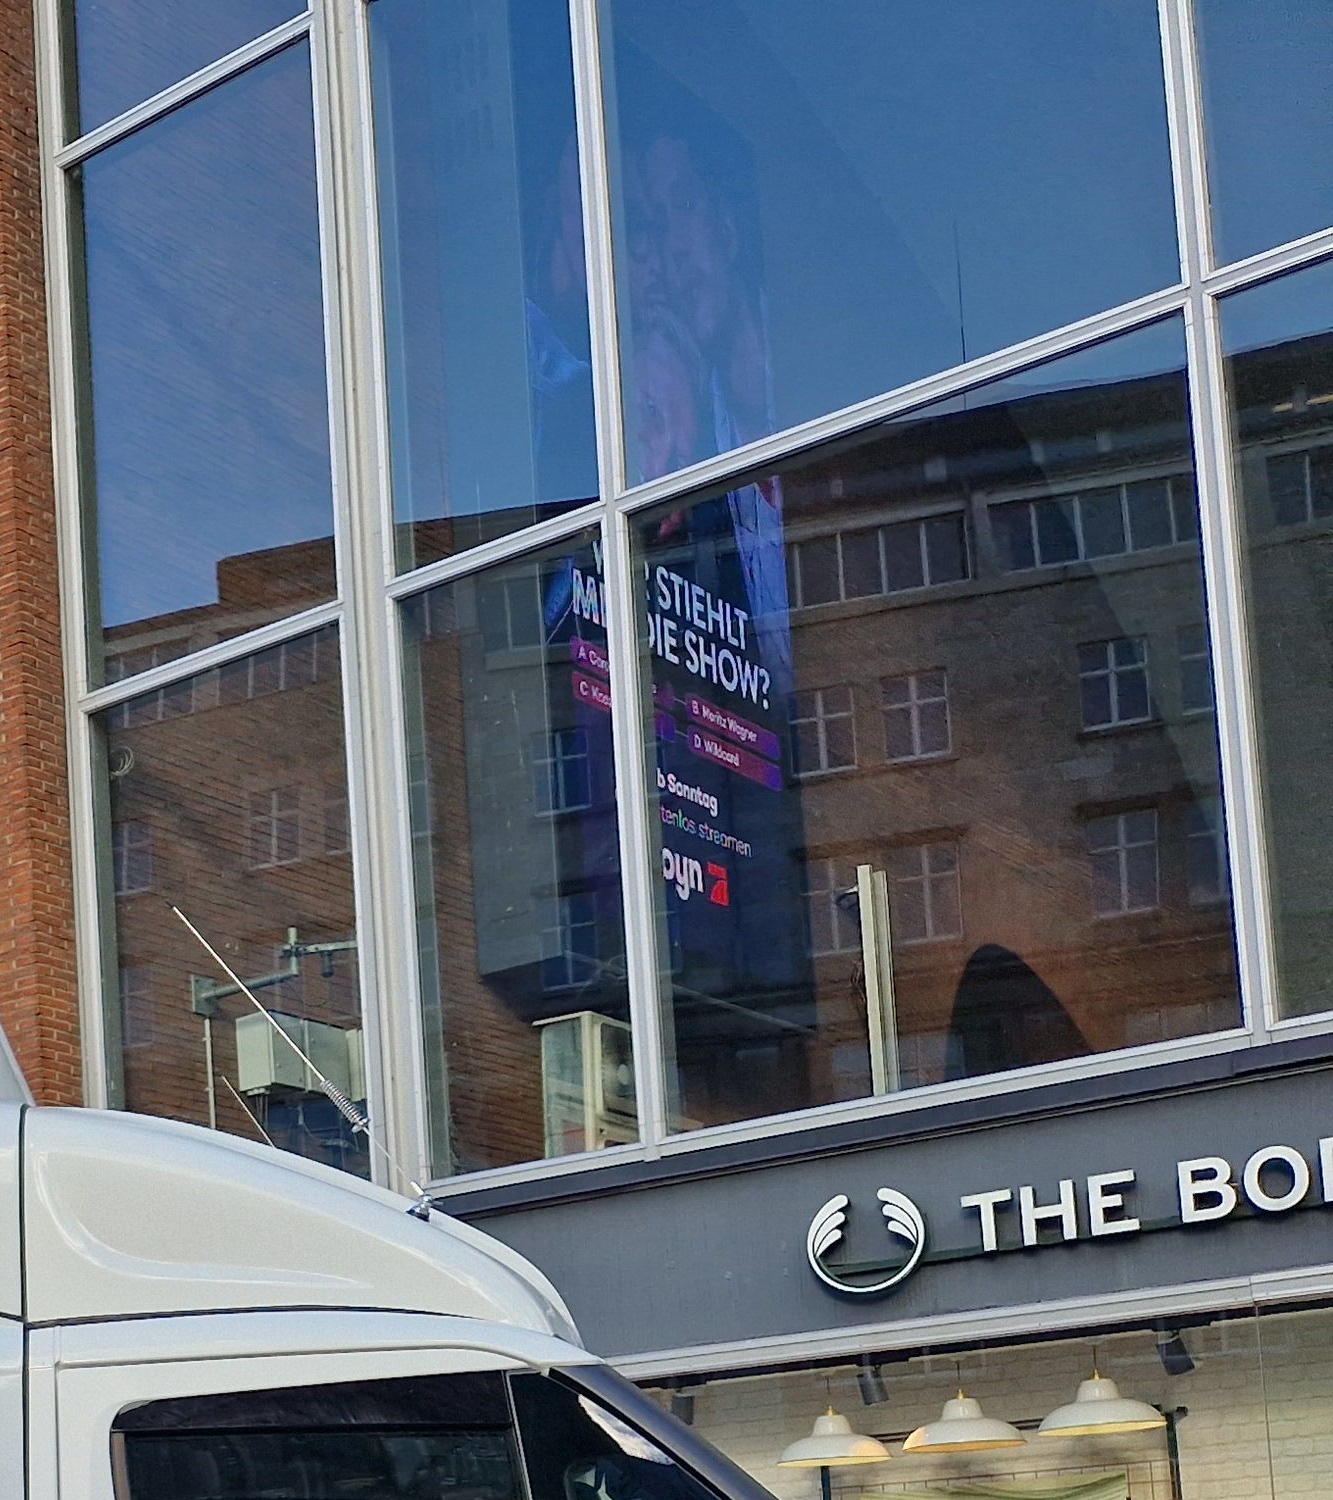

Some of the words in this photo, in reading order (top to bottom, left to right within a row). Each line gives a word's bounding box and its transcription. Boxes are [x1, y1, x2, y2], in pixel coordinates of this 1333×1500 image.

[572, 567, 608, 629] MI
[684, 629, 772, 710] SHOW?
[656, 565, 749, 651] STIEHLT
[661, 804, 697, 835] tenlos
[667, 772, 718, 818] Sonntag
[662, 848, 705, 901] oyn
[960, 1169, 1140, 1252] THE
[1176, 1137, 1333, 1224] BO
